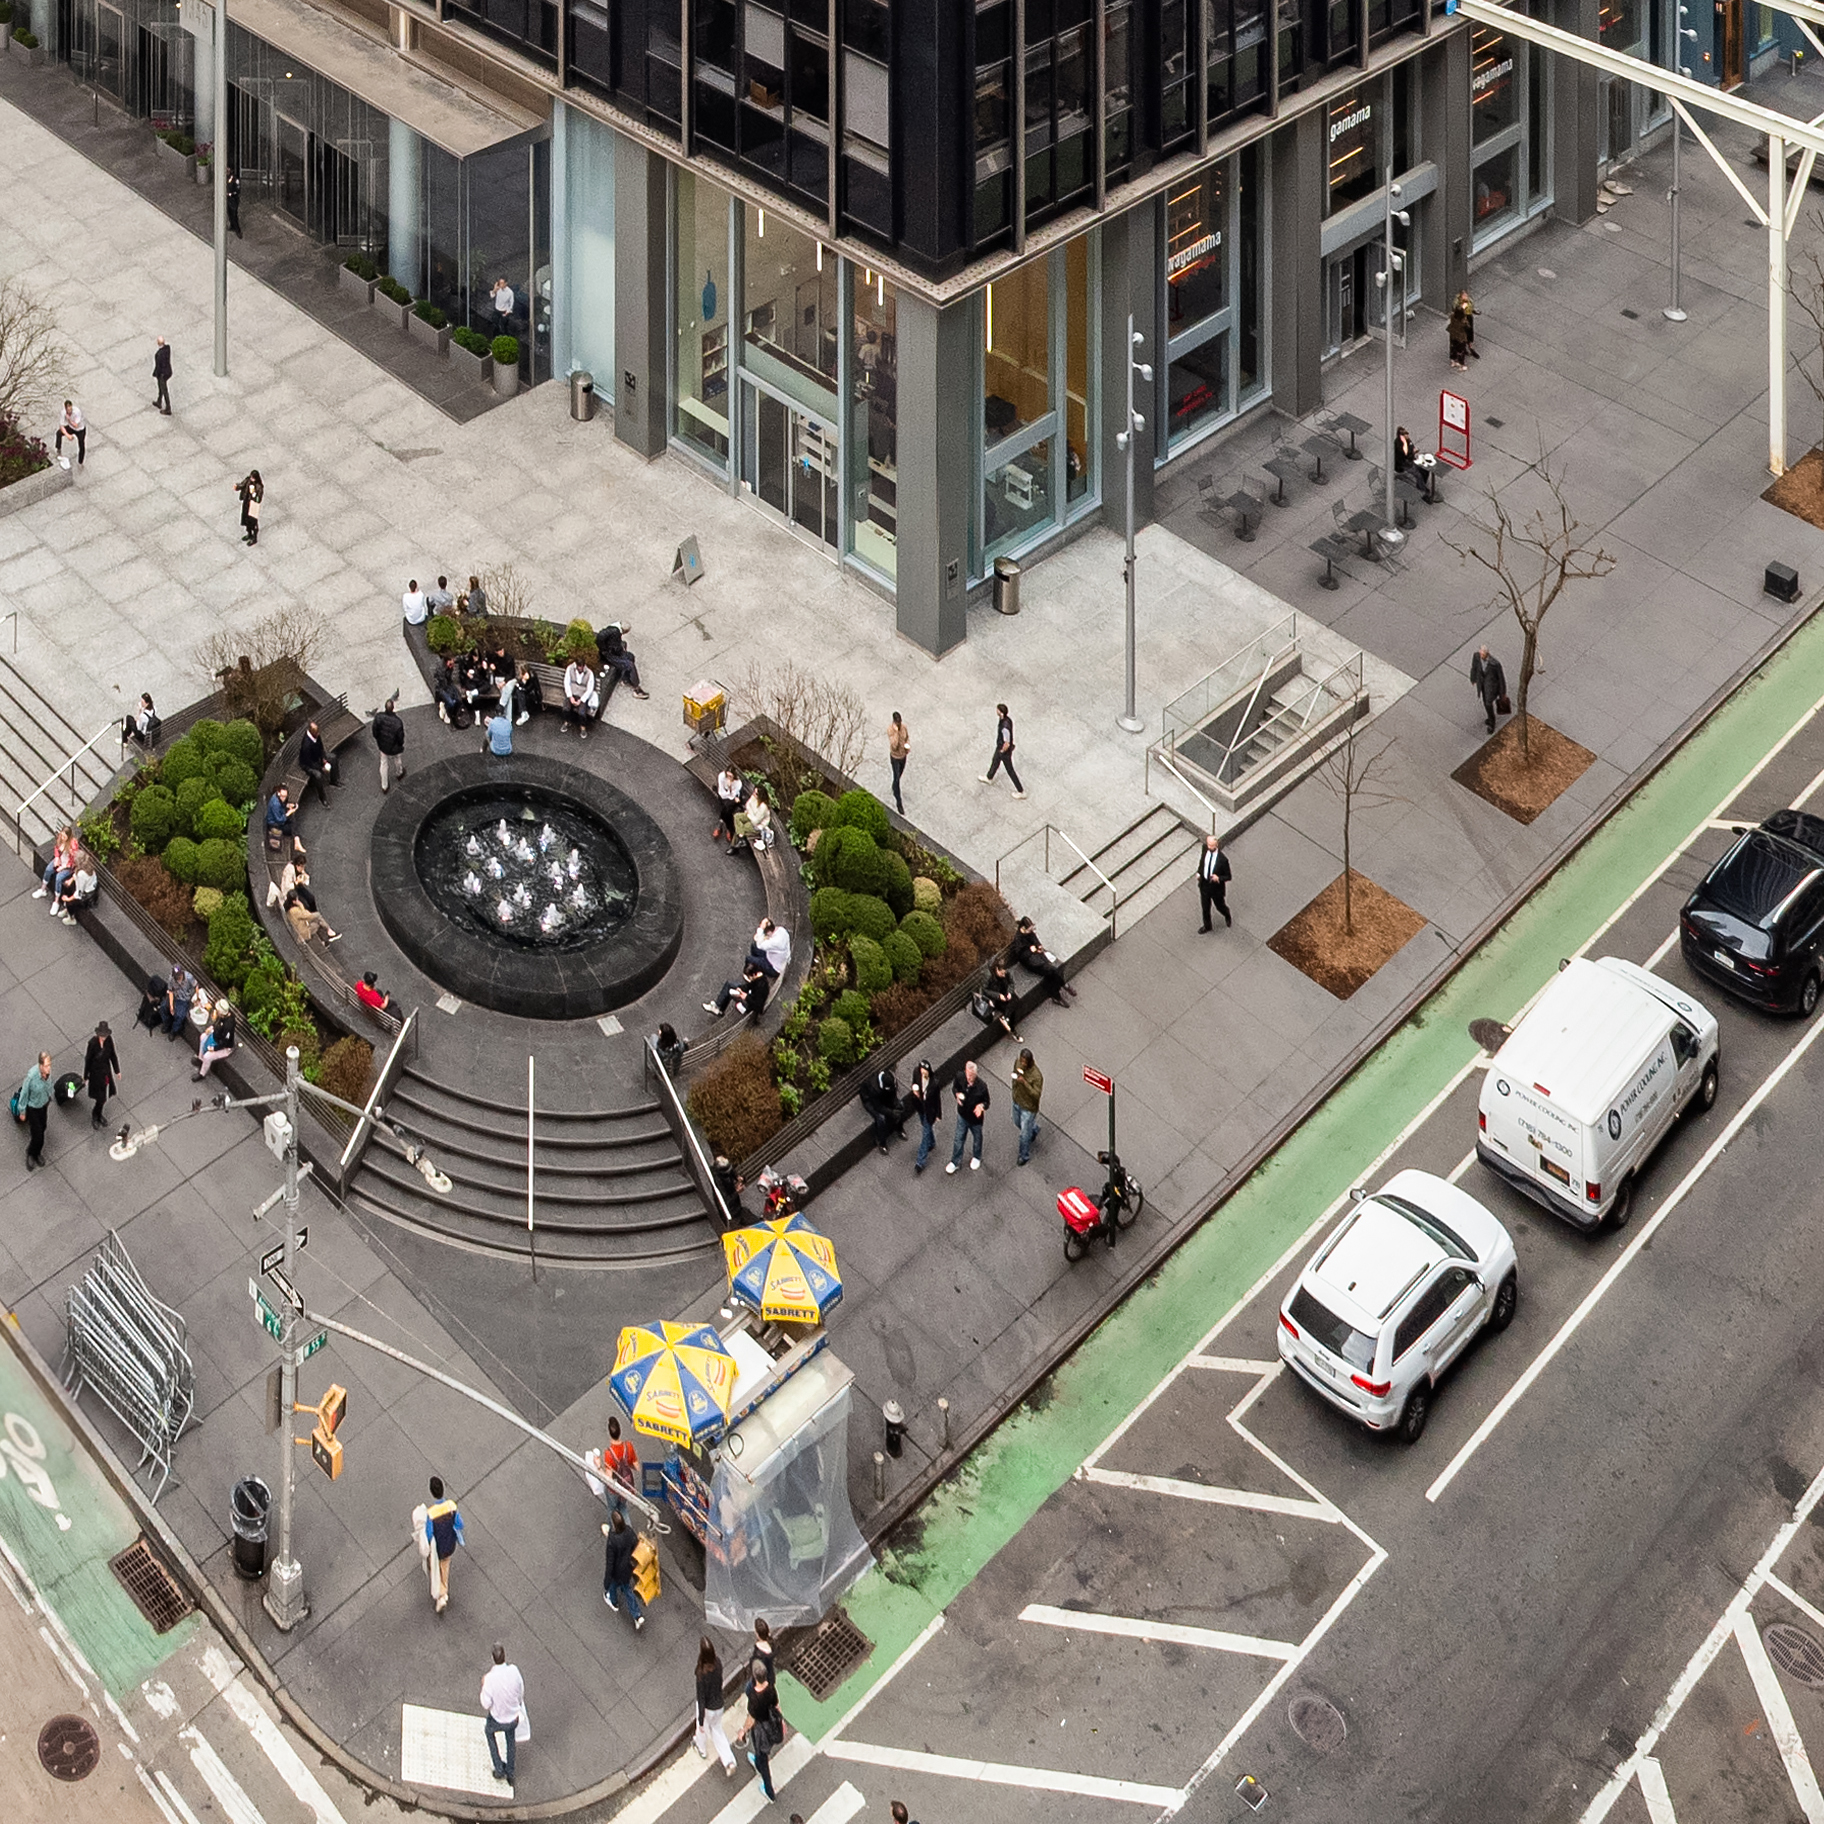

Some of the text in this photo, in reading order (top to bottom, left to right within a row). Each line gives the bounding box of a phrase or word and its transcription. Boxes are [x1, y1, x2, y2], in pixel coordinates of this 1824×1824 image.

[1330, 105, 1371, 143] gamama
[1167, 231, 1222, 273] wagamama
[1620, 1087, 1639, 1116] POWER
[1637, 1062, 1660, 1095] COOLING
[1515, 1090, 1537, 1108] POWER
[1538, 1105, 1566, 1126] COOLING
[770, 1276, 802, 1291] SABRETT
[765, 1306, 816, 1320] SABRETT
[647, 1390, 680, 1402] SABRETT
[637, 1418, 688, 1442] SABRETT
